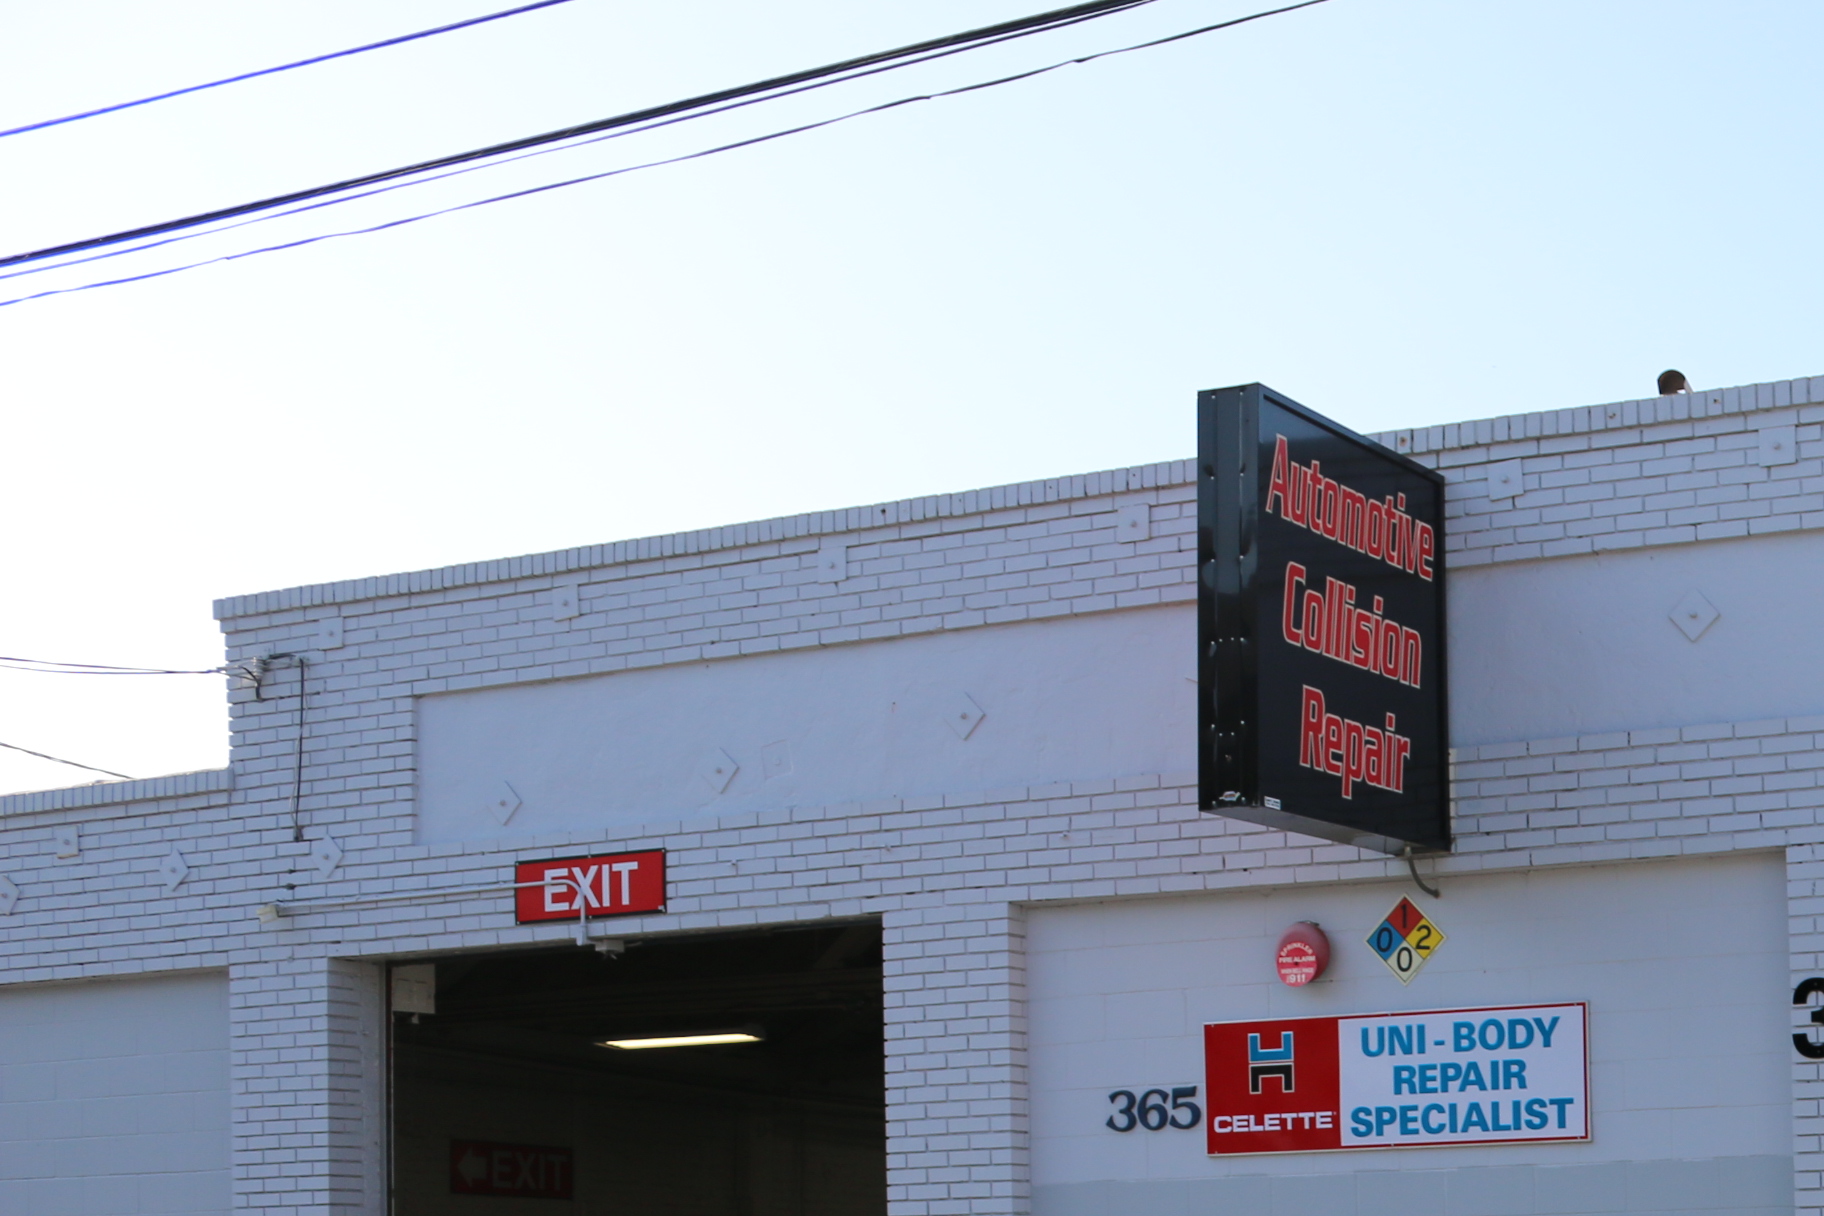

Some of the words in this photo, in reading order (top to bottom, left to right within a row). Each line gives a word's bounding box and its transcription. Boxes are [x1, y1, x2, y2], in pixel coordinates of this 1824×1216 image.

[1266, 433, 1434, 581] Automotive
[1282, 561, 1421, 689] Collision
[1300, 684, 1410, 799] Repair
[543, 861, 638, 913] EXIT
[1401, 904, 1408, 929] 1
[1376, 927, 1393, 953] 0
[1415, 924, 1431, 950] 2
[1397, 946, 1412, 972] 0
[1393, 1059, 1527, 1096] REPAIR
[1106, 1085, 1201, 1132] 365
[1213, 1111, 1333, 1133] CELETTE
[1350, 1097, 1574, 1137] SPECIALIST
[492, 1150, 567, 1192] EXIT
